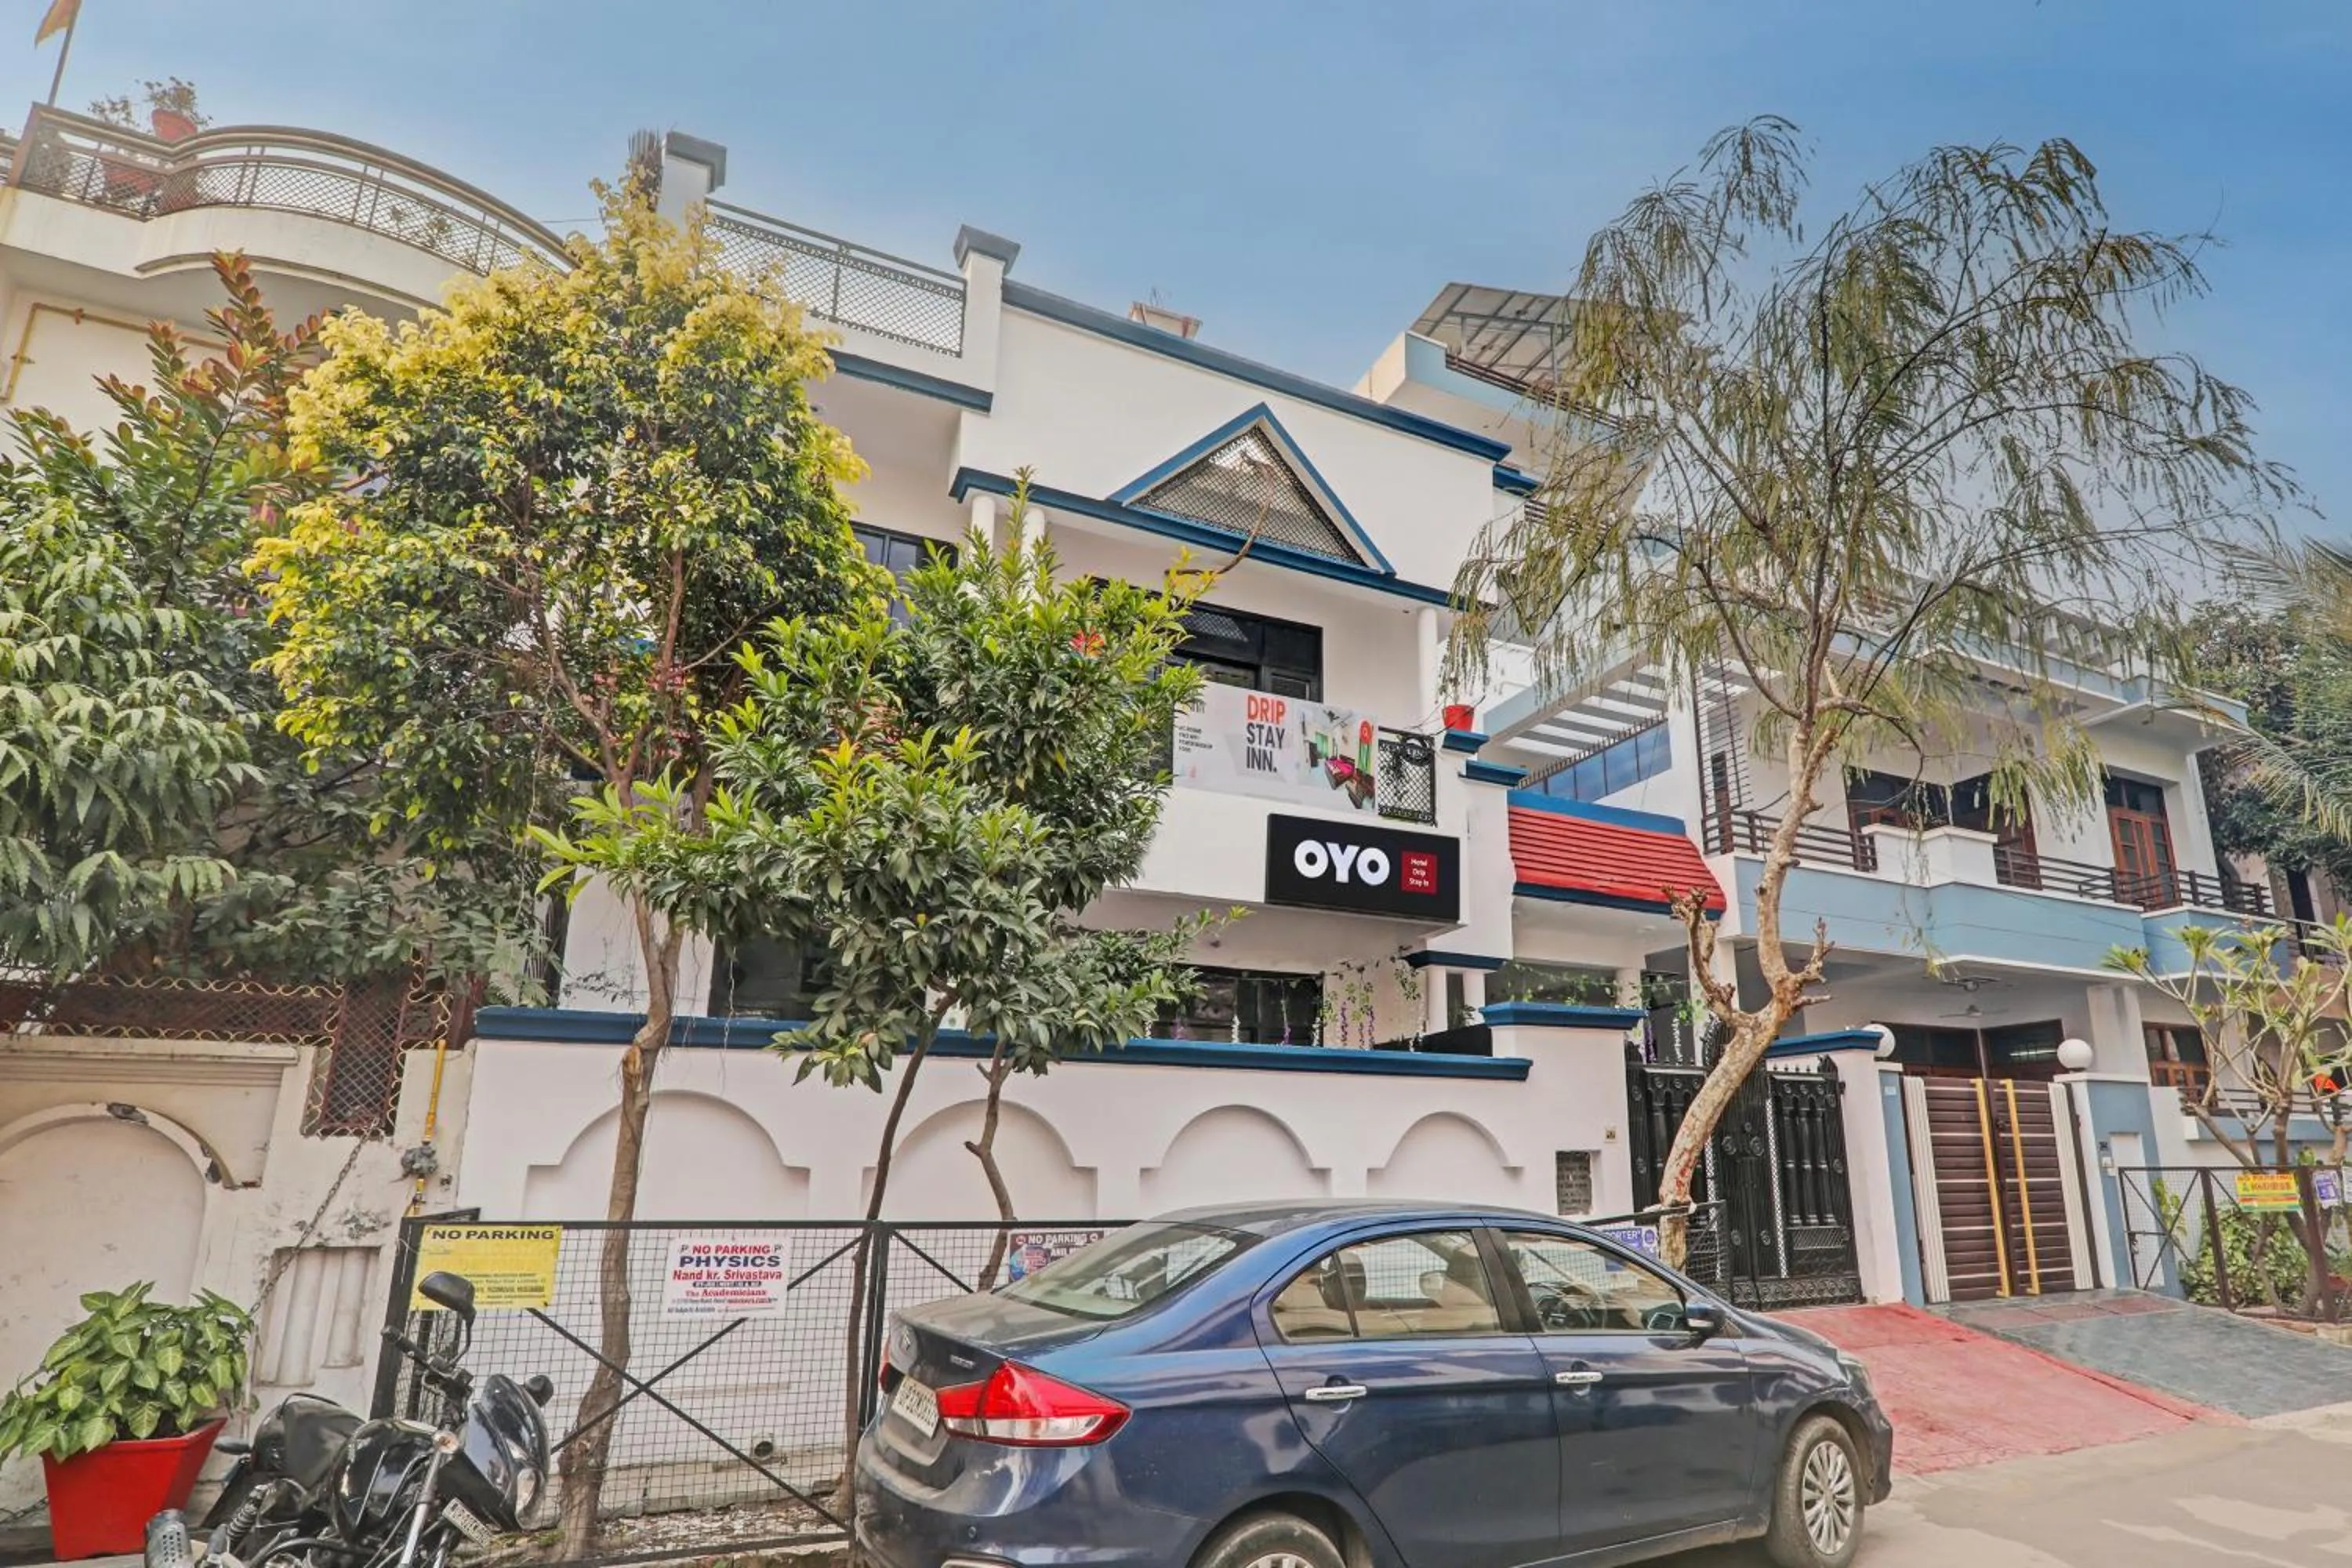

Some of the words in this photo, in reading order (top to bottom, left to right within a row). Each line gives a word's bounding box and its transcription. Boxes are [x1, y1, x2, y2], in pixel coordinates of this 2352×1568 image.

[1247, 694, 1286, 725] DRIP
[1247, 723, 1286, 750] STAY
[1246, 746, 1278, 774] INN.
[1294, 839, 1390, 887] OYO
[1412, 868, 1426, 877] Drip
[1409, 878, 1422, 887] Stay
[432, 1229, 461, 1240] NO
[466, 1229, 554, 1240] PARKING
[1028, 1234, 1043, 1245] NO
[1045, 1233, 1087, 1244] PARKING
[692, 1244, 711, 1254] NO
[715, 1244, 771, 1254] PARKING
[680, 1255, 780, 1268] PHYSICS
[673, 1269, 703, 1280] Nand
[706, 1269, 720, 1280] kr.
[724, 1269, 782, 1280] Srivastava
[702, 1288, 767, 1297] Academicians
